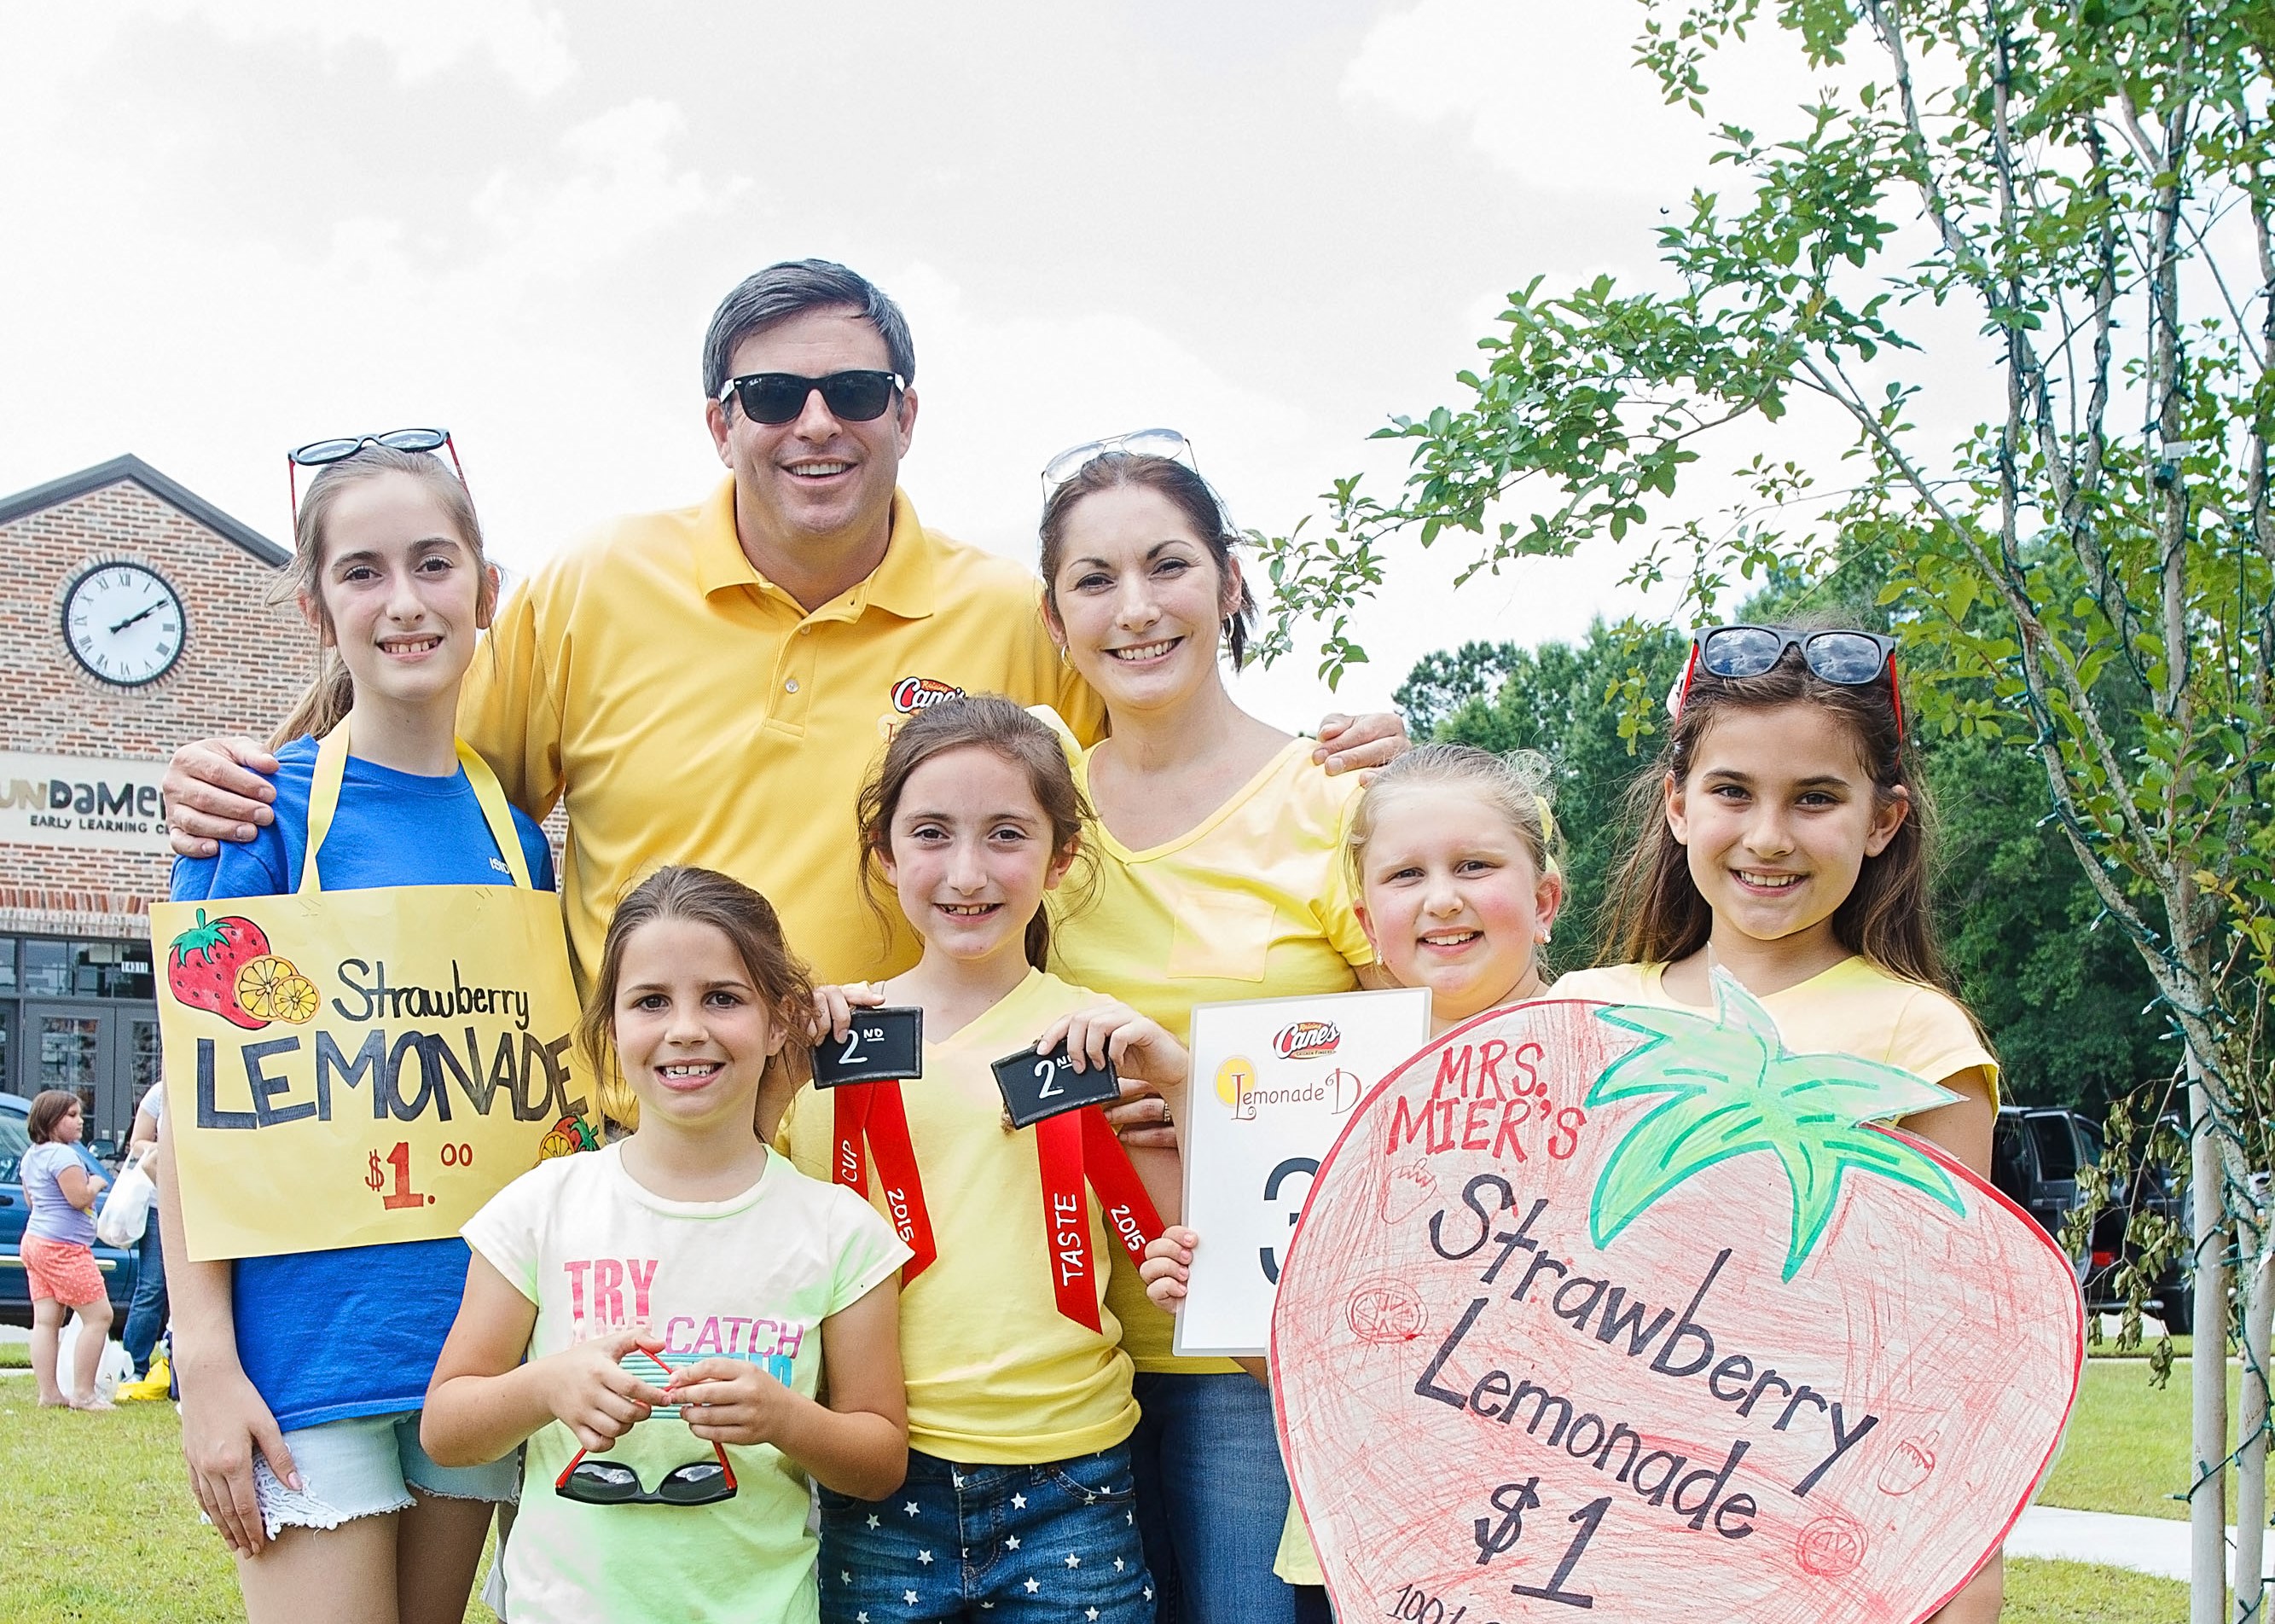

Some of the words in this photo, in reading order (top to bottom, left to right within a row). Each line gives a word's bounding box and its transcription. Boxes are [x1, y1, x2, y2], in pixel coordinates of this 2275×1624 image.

[30, 815, 72, 830] EARLY
[79, 819, 148, 832] LEARNING
[332, 959, 530, 1030] Strawberry
[1275, 1021, 1341, 1059] Cane's
[1431, 1039, 1548, 1102] MRS.
[196, 1027, 589, 1130] LEMONADE
[1231, 1074, 1324, 1121] Lemonade
[1326, 1068, 1370, 1115] D
[1385, 1095, 1587, 1163] MIER'S
[841, 1140, 858, 1183] CUP
[887, 1188, 914, 1243] 2015
[1055, 1193, 1082, 1287] TASTE
[1111, 1204, 1146, 1252] 2015
[564, 1259, 659, 1324] TRY
[665, 1316, 804, 1359] CATCH
[1429, 1174, 1879, 1498] Strawberry
[1414, 1297, 1758, 1539] Lemonade
